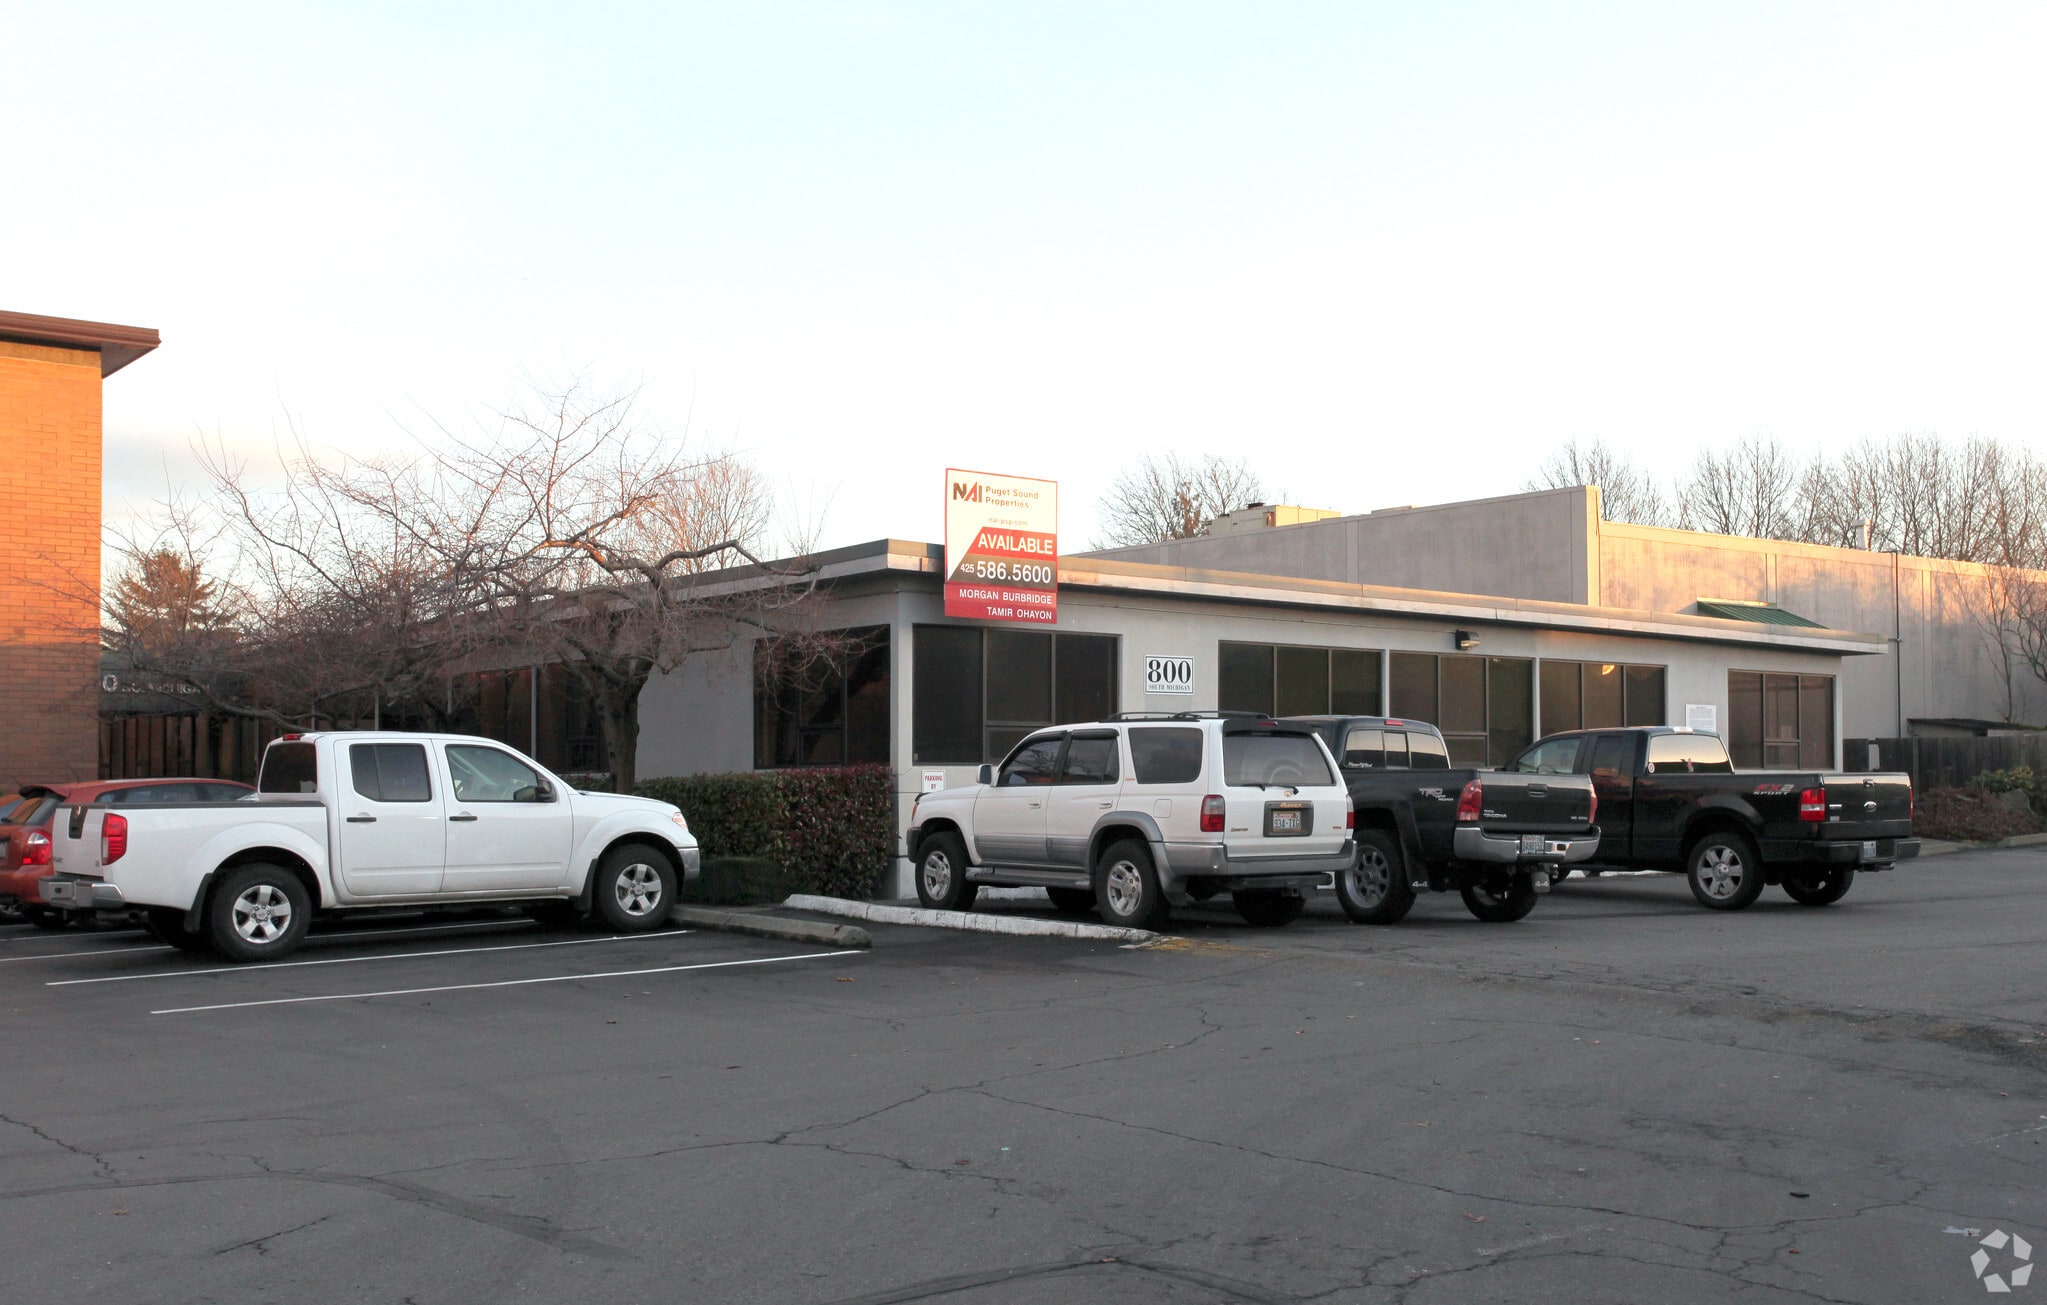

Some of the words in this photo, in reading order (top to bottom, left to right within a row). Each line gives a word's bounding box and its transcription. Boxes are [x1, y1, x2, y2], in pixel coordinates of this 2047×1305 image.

[953, 481, 983, 503] NAI
[985, 486, 1010, 496] Puget
[1013, 489, 1039, 499] Sound
[985, 497, 1029, 508] Properties
[978, 533, 1053, 555] AVAILABLE
[960, 563, 974, 573] 425
[976, 561, 1051, 584] 586.5600
[959, 589, 999, 600] MORGAN
[1003, 592, 1052, 604] BURBRIDGE
[987, 606, 1013, 617] TAMIR
[1017, 609, 1052, 620] OHAYON
[1148, 659, 1191, 684] 800
